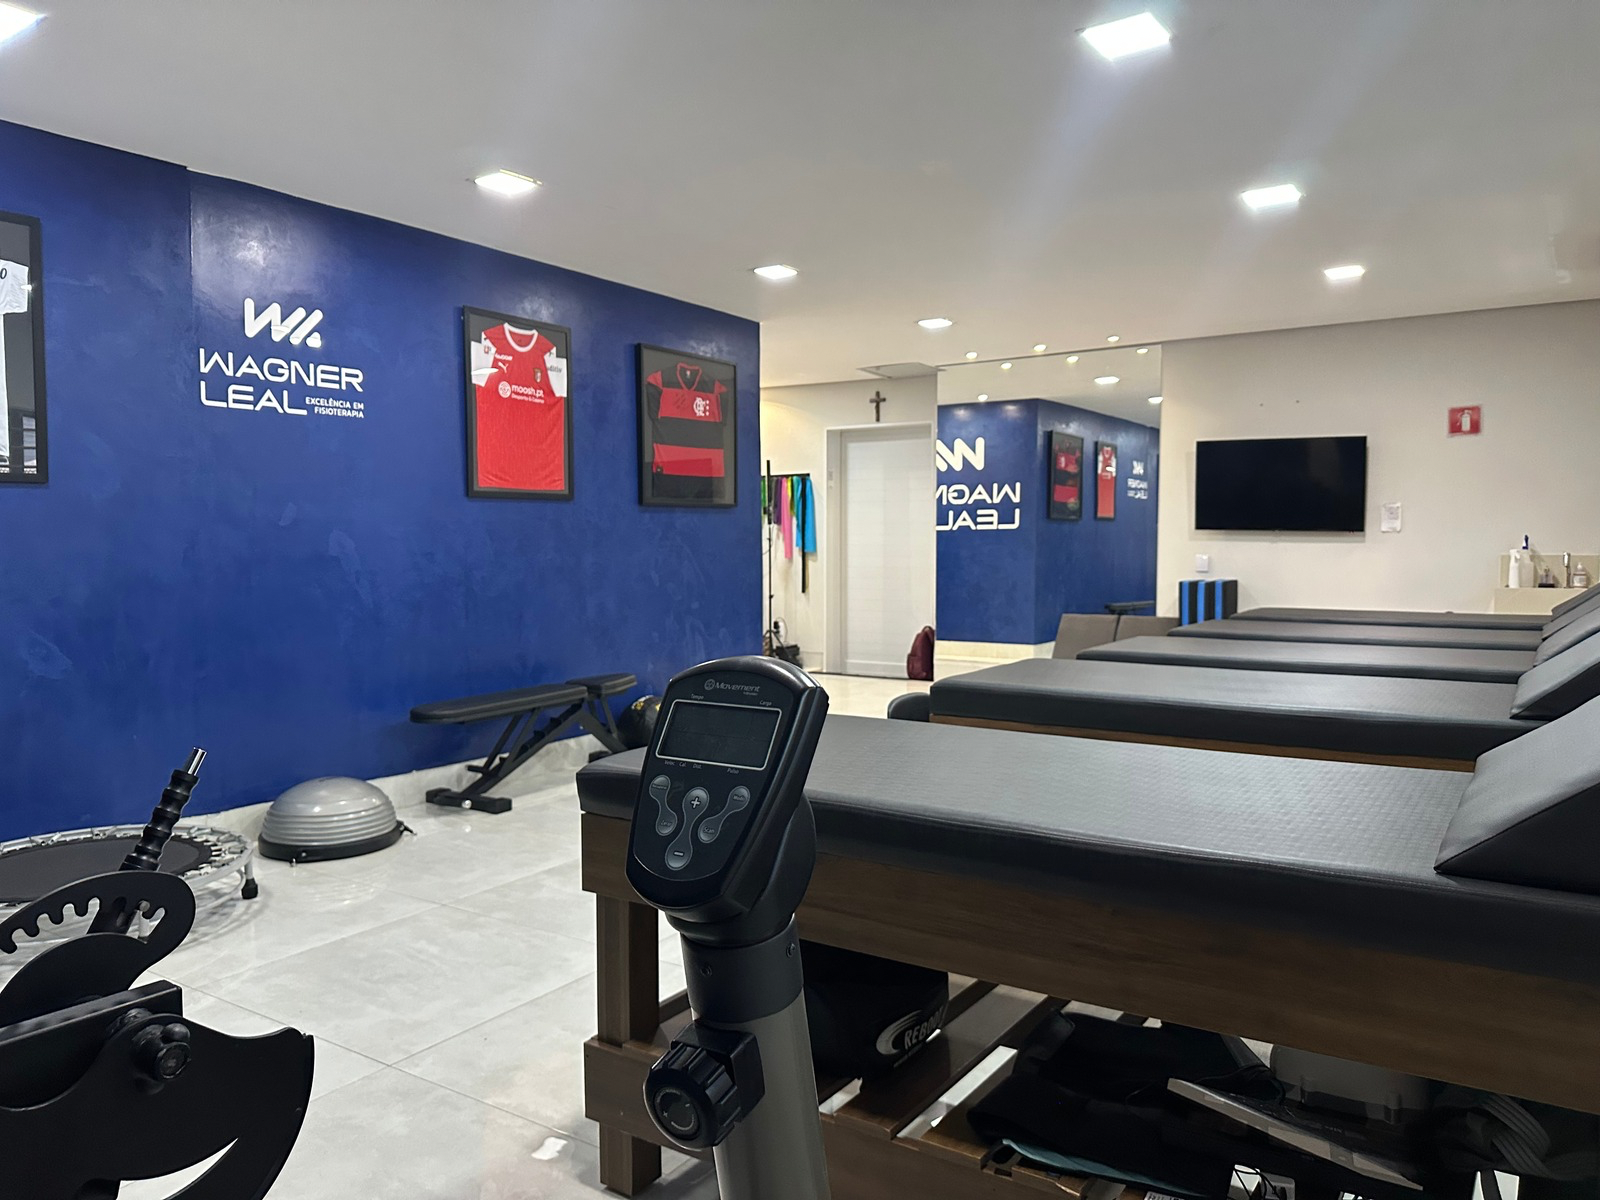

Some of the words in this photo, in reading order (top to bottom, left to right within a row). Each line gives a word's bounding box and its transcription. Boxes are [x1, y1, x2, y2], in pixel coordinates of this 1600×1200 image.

[198, 347, 365, 392] WAGNER
[199, 380, 308, 416] LEAL
[511, 384, 544, 398] moosh.pt
[305, 396, 351, 409] EXCELÊNCIA
[353, 401, 365, 410] EM
[314, 406, 365, 419] FISIOTERAPIA
[714, 681, 761, 693] Movement
